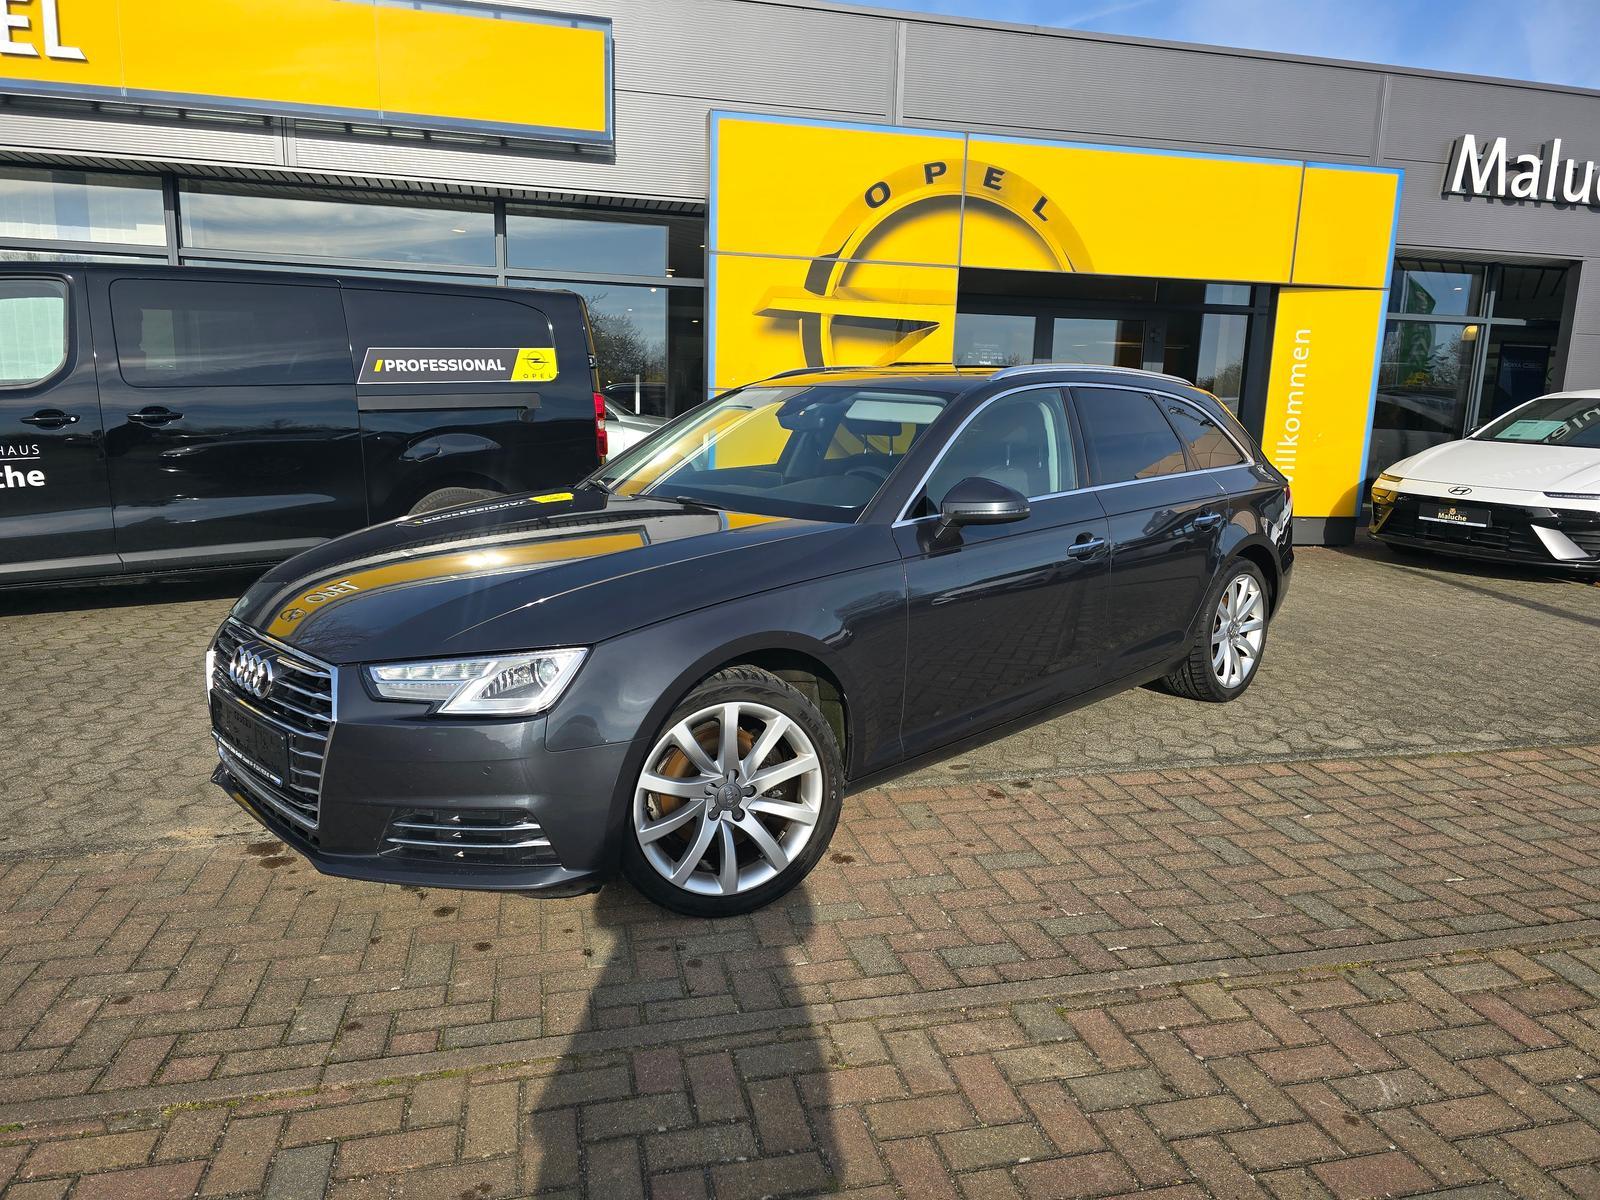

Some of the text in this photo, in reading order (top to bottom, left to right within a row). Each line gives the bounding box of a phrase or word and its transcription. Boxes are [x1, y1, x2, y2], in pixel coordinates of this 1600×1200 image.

[0, 0, 88, 60] EL
[864, 161, 1048, 222] OPEL
[1449, 134, 1600, 204] Malu
[384, 358, 506, 372] PROFESSIONAL
[1275, 328, 1312, 483] illkommen
[1437, 512, 1467, 522] Maluche
